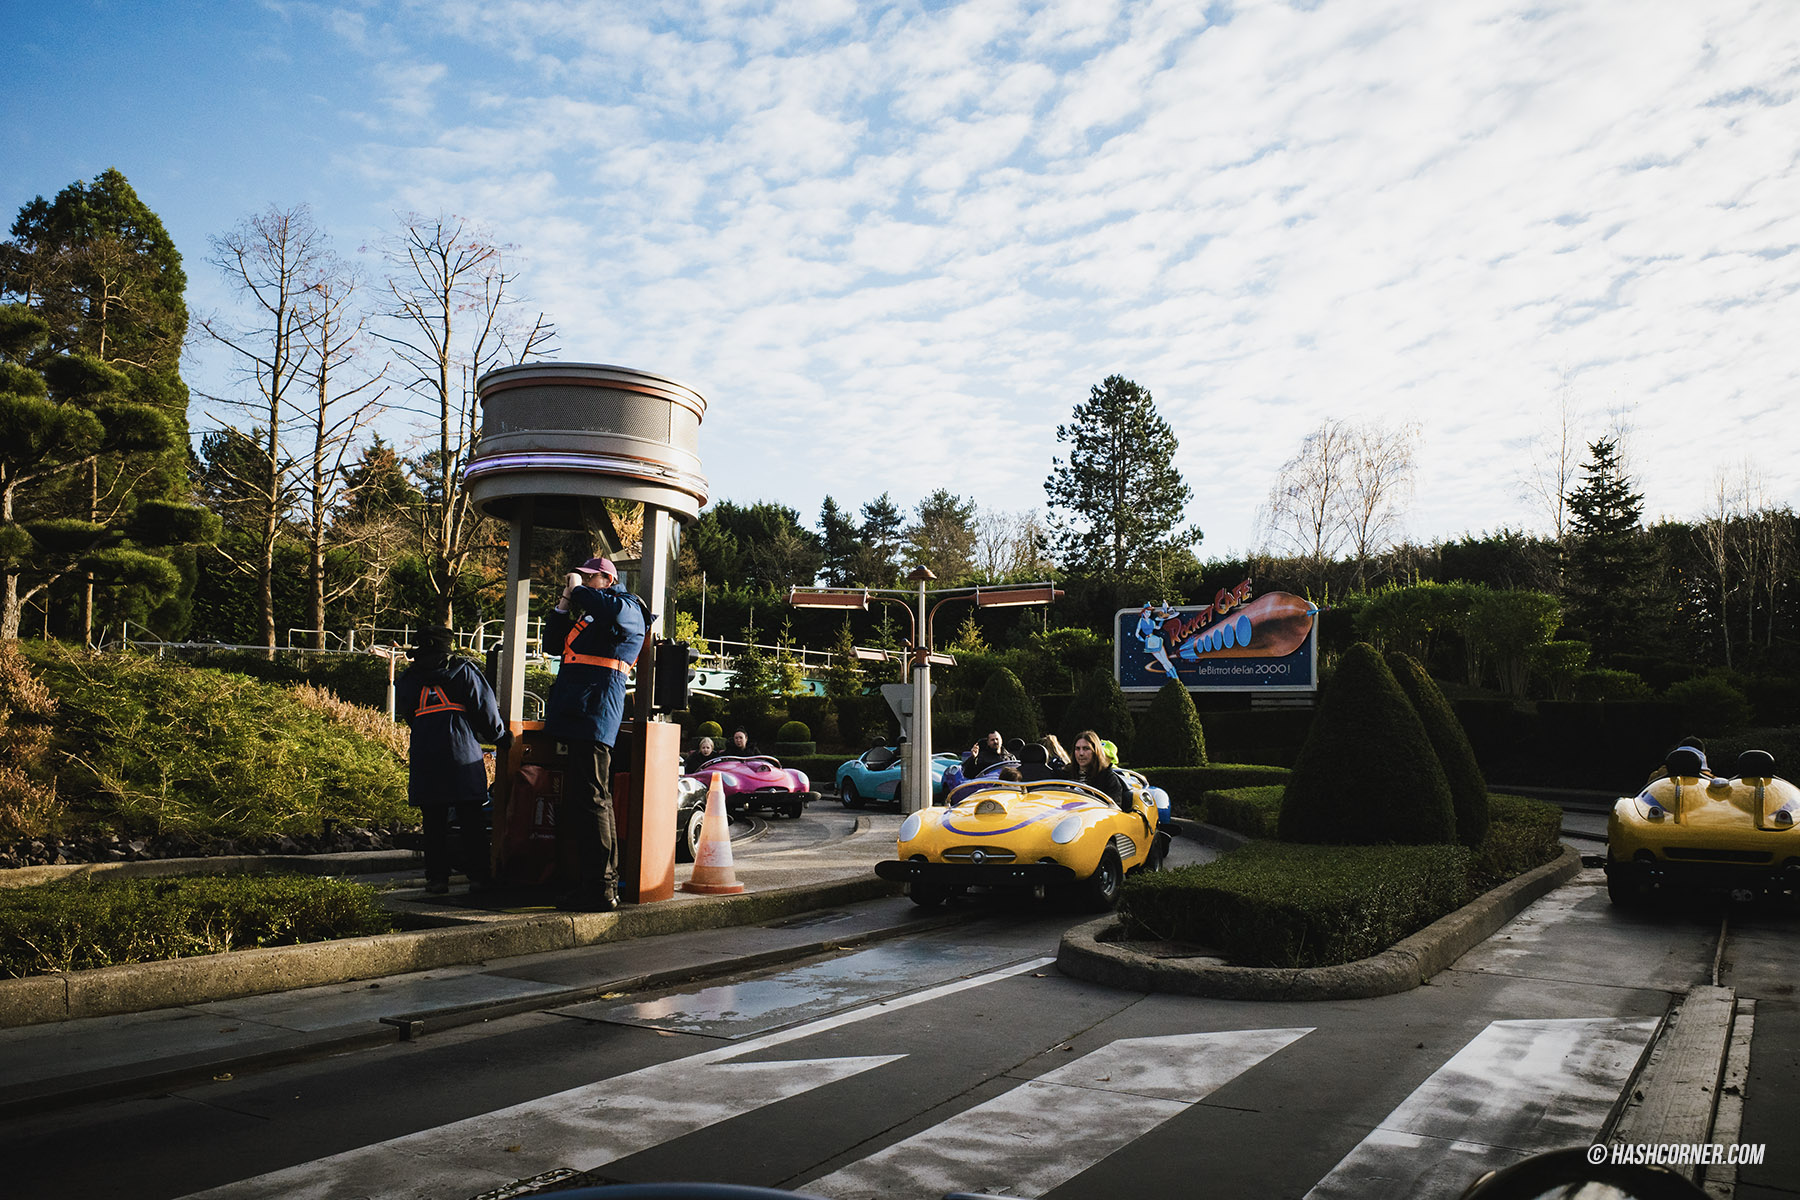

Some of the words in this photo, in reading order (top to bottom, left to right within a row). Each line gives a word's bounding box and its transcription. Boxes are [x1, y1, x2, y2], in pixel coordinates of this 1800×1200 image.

[1163, 603, 1214, 647] ROCKET
[1207, 665, 1231, 675] Bistrot
[1231, 665, 1242, 675] de
